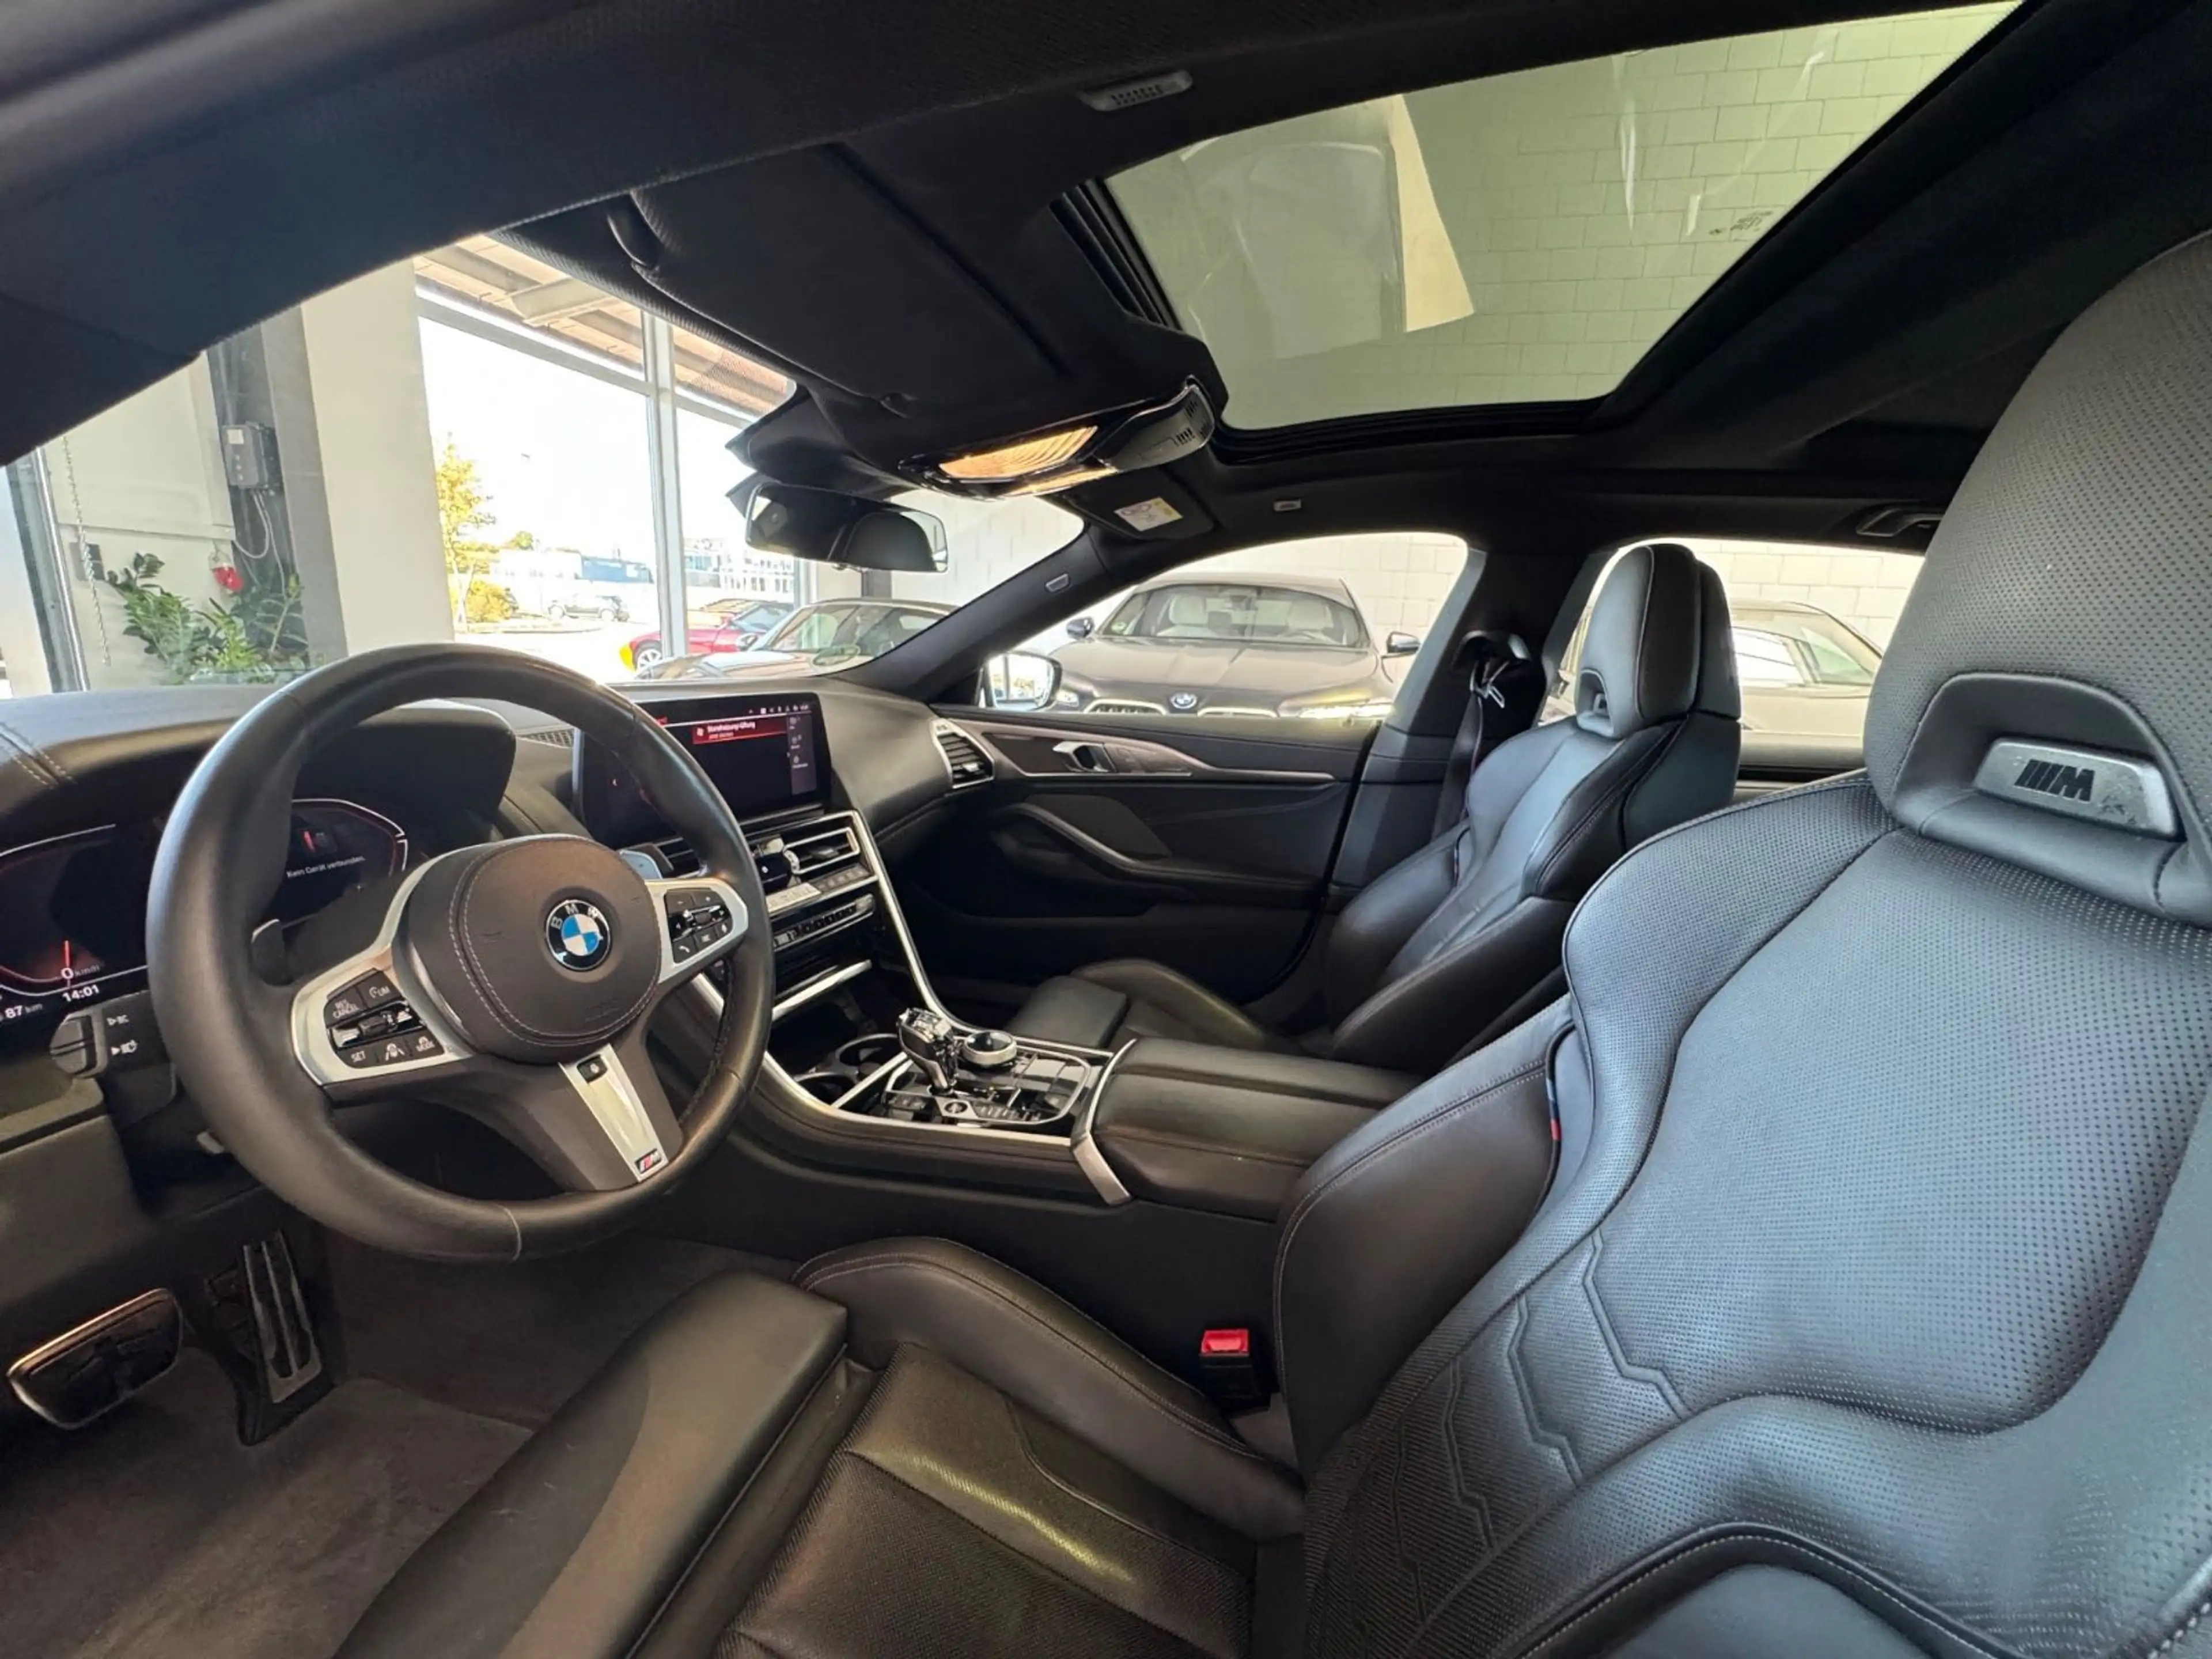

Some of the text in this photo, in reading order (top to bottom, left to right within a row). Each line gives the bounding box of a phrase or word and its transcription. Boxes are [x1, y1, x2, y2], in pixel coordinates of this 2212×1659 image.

[550, 903, 600, 930] BMW
[60, 967, 74, 979] 0
[62, 984, 100, 1002] 14:01
[4, 1003, 43, 1018] 87 km
[351, 1050, 366, 1063] SET
